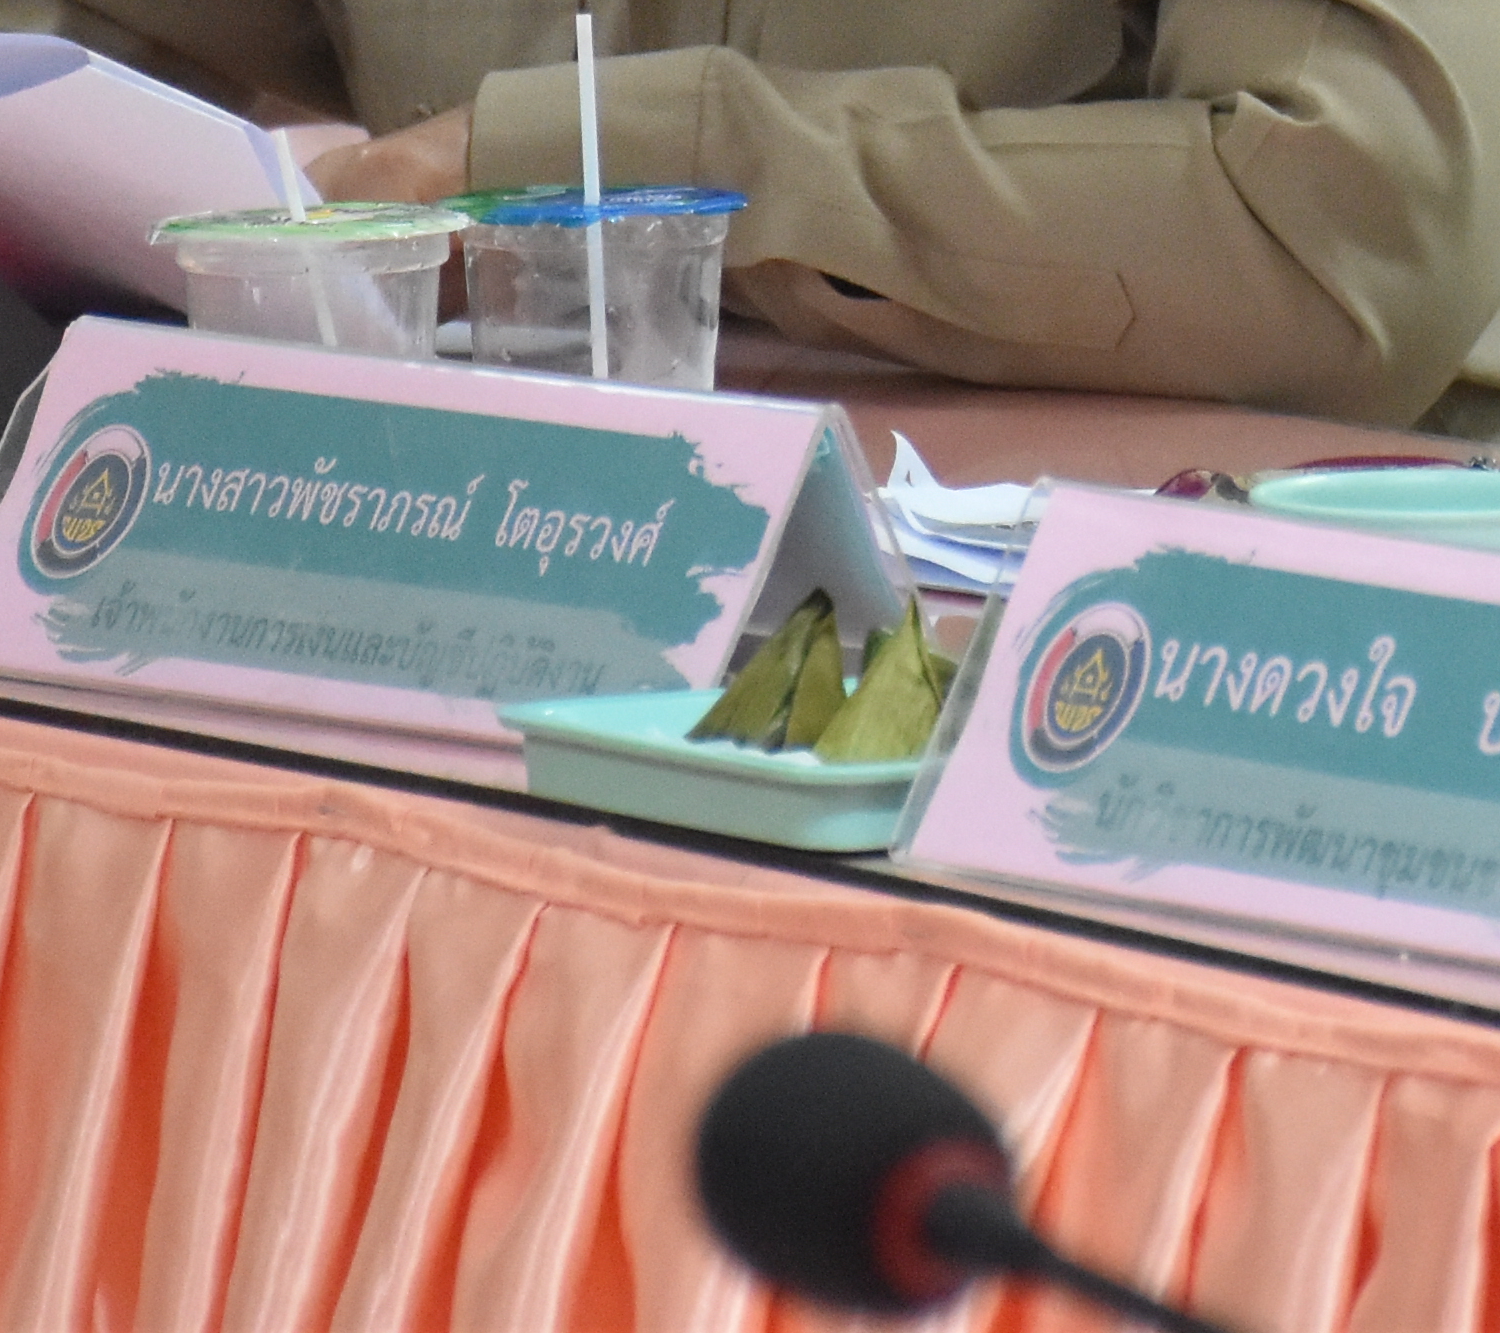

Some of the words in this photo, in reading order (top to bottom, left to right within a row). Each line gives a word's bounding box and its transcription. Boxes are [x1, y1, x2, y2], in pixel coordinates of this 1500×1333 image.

[152, 455, 486, 542] นางสาวพัชราภรณ์
[494, 479, 676, 577] โตอุรวงศ์
[1153, 635, 1418, 738] นางดวงใจ
